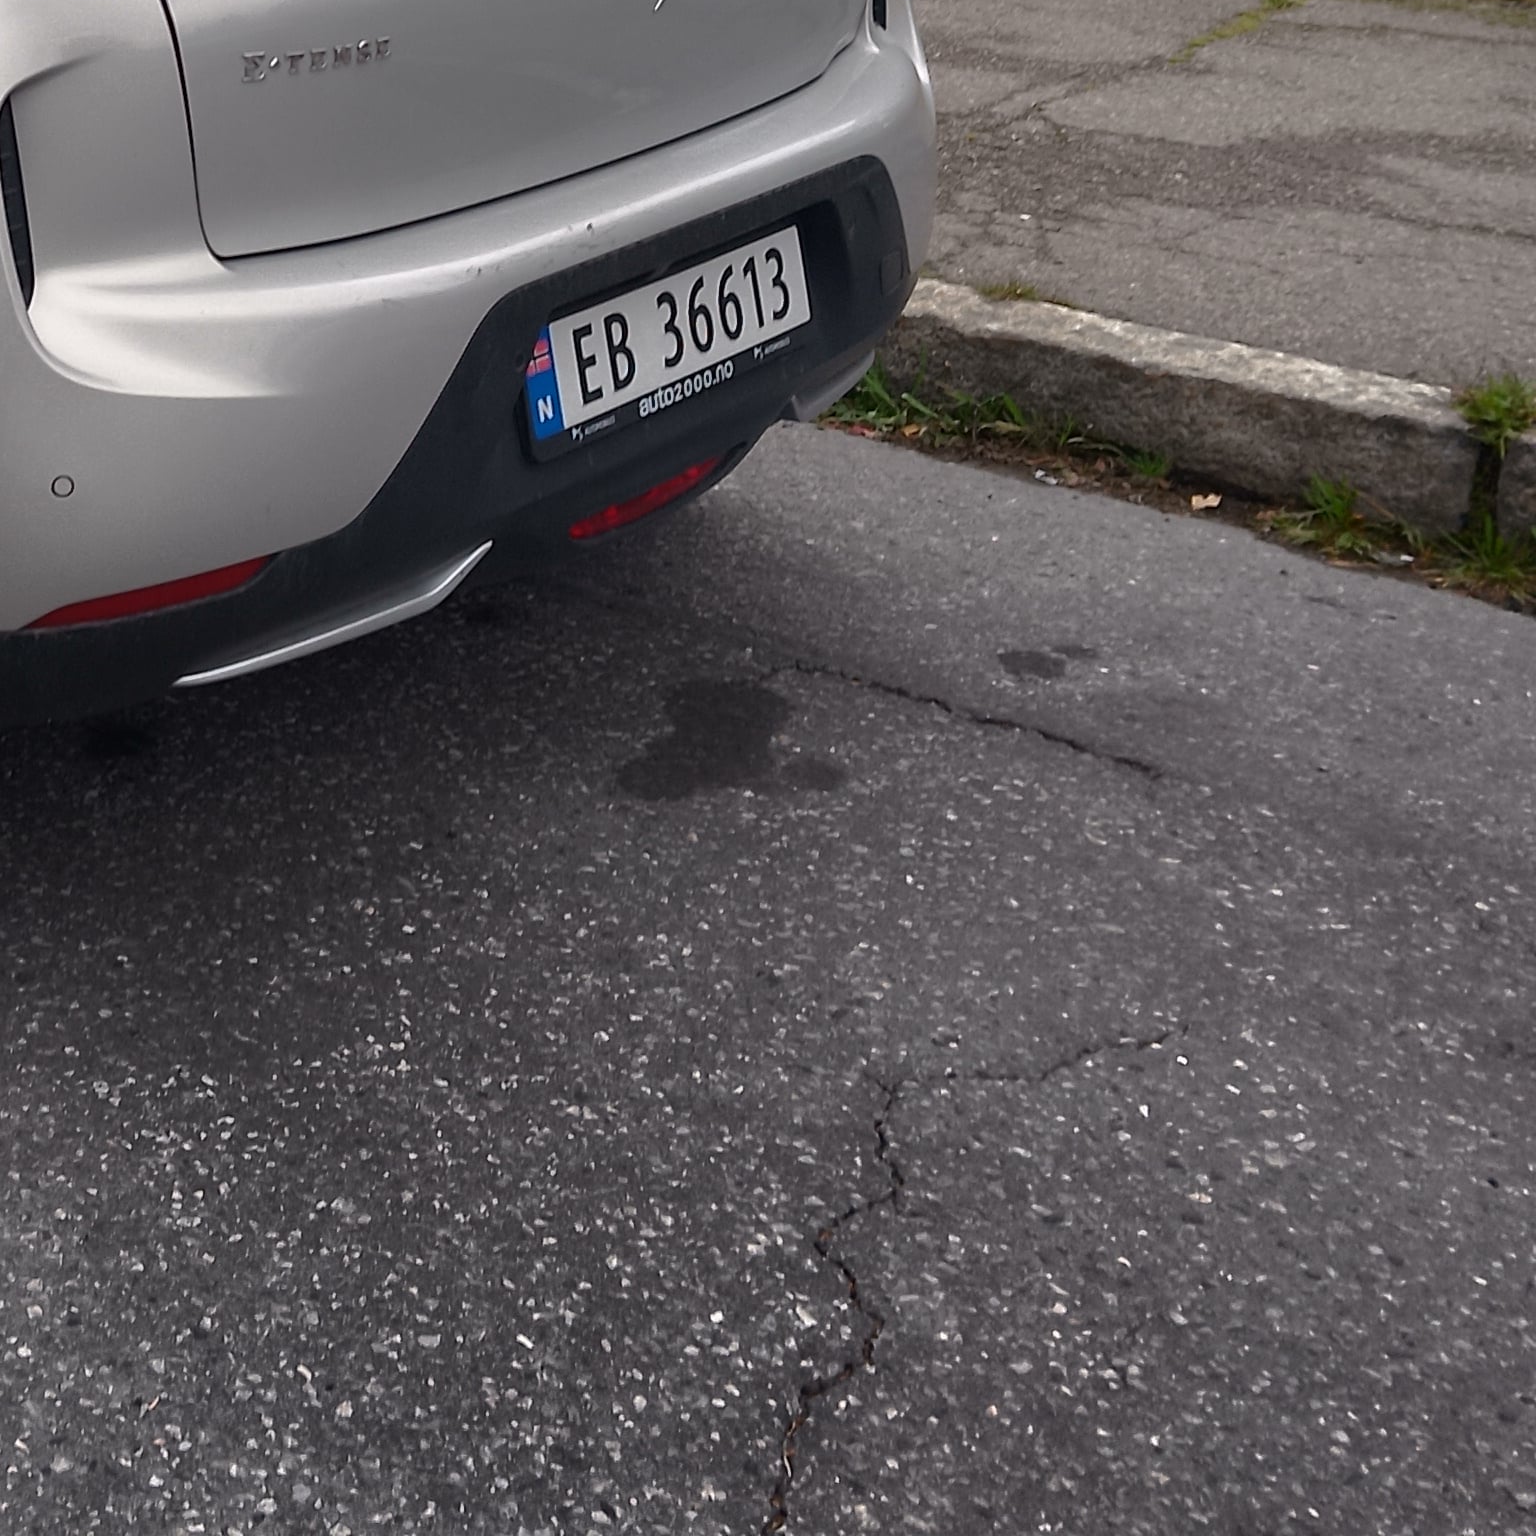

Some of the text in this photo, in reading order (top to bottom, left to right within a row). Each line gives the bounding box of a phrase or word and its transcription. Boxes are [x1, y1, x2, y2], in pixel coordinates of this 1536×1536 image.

[571, 247, 791, 406] EB 36613
[537, 395, 553, 423] N
[638, 359, 735, 418] auto2000.no
